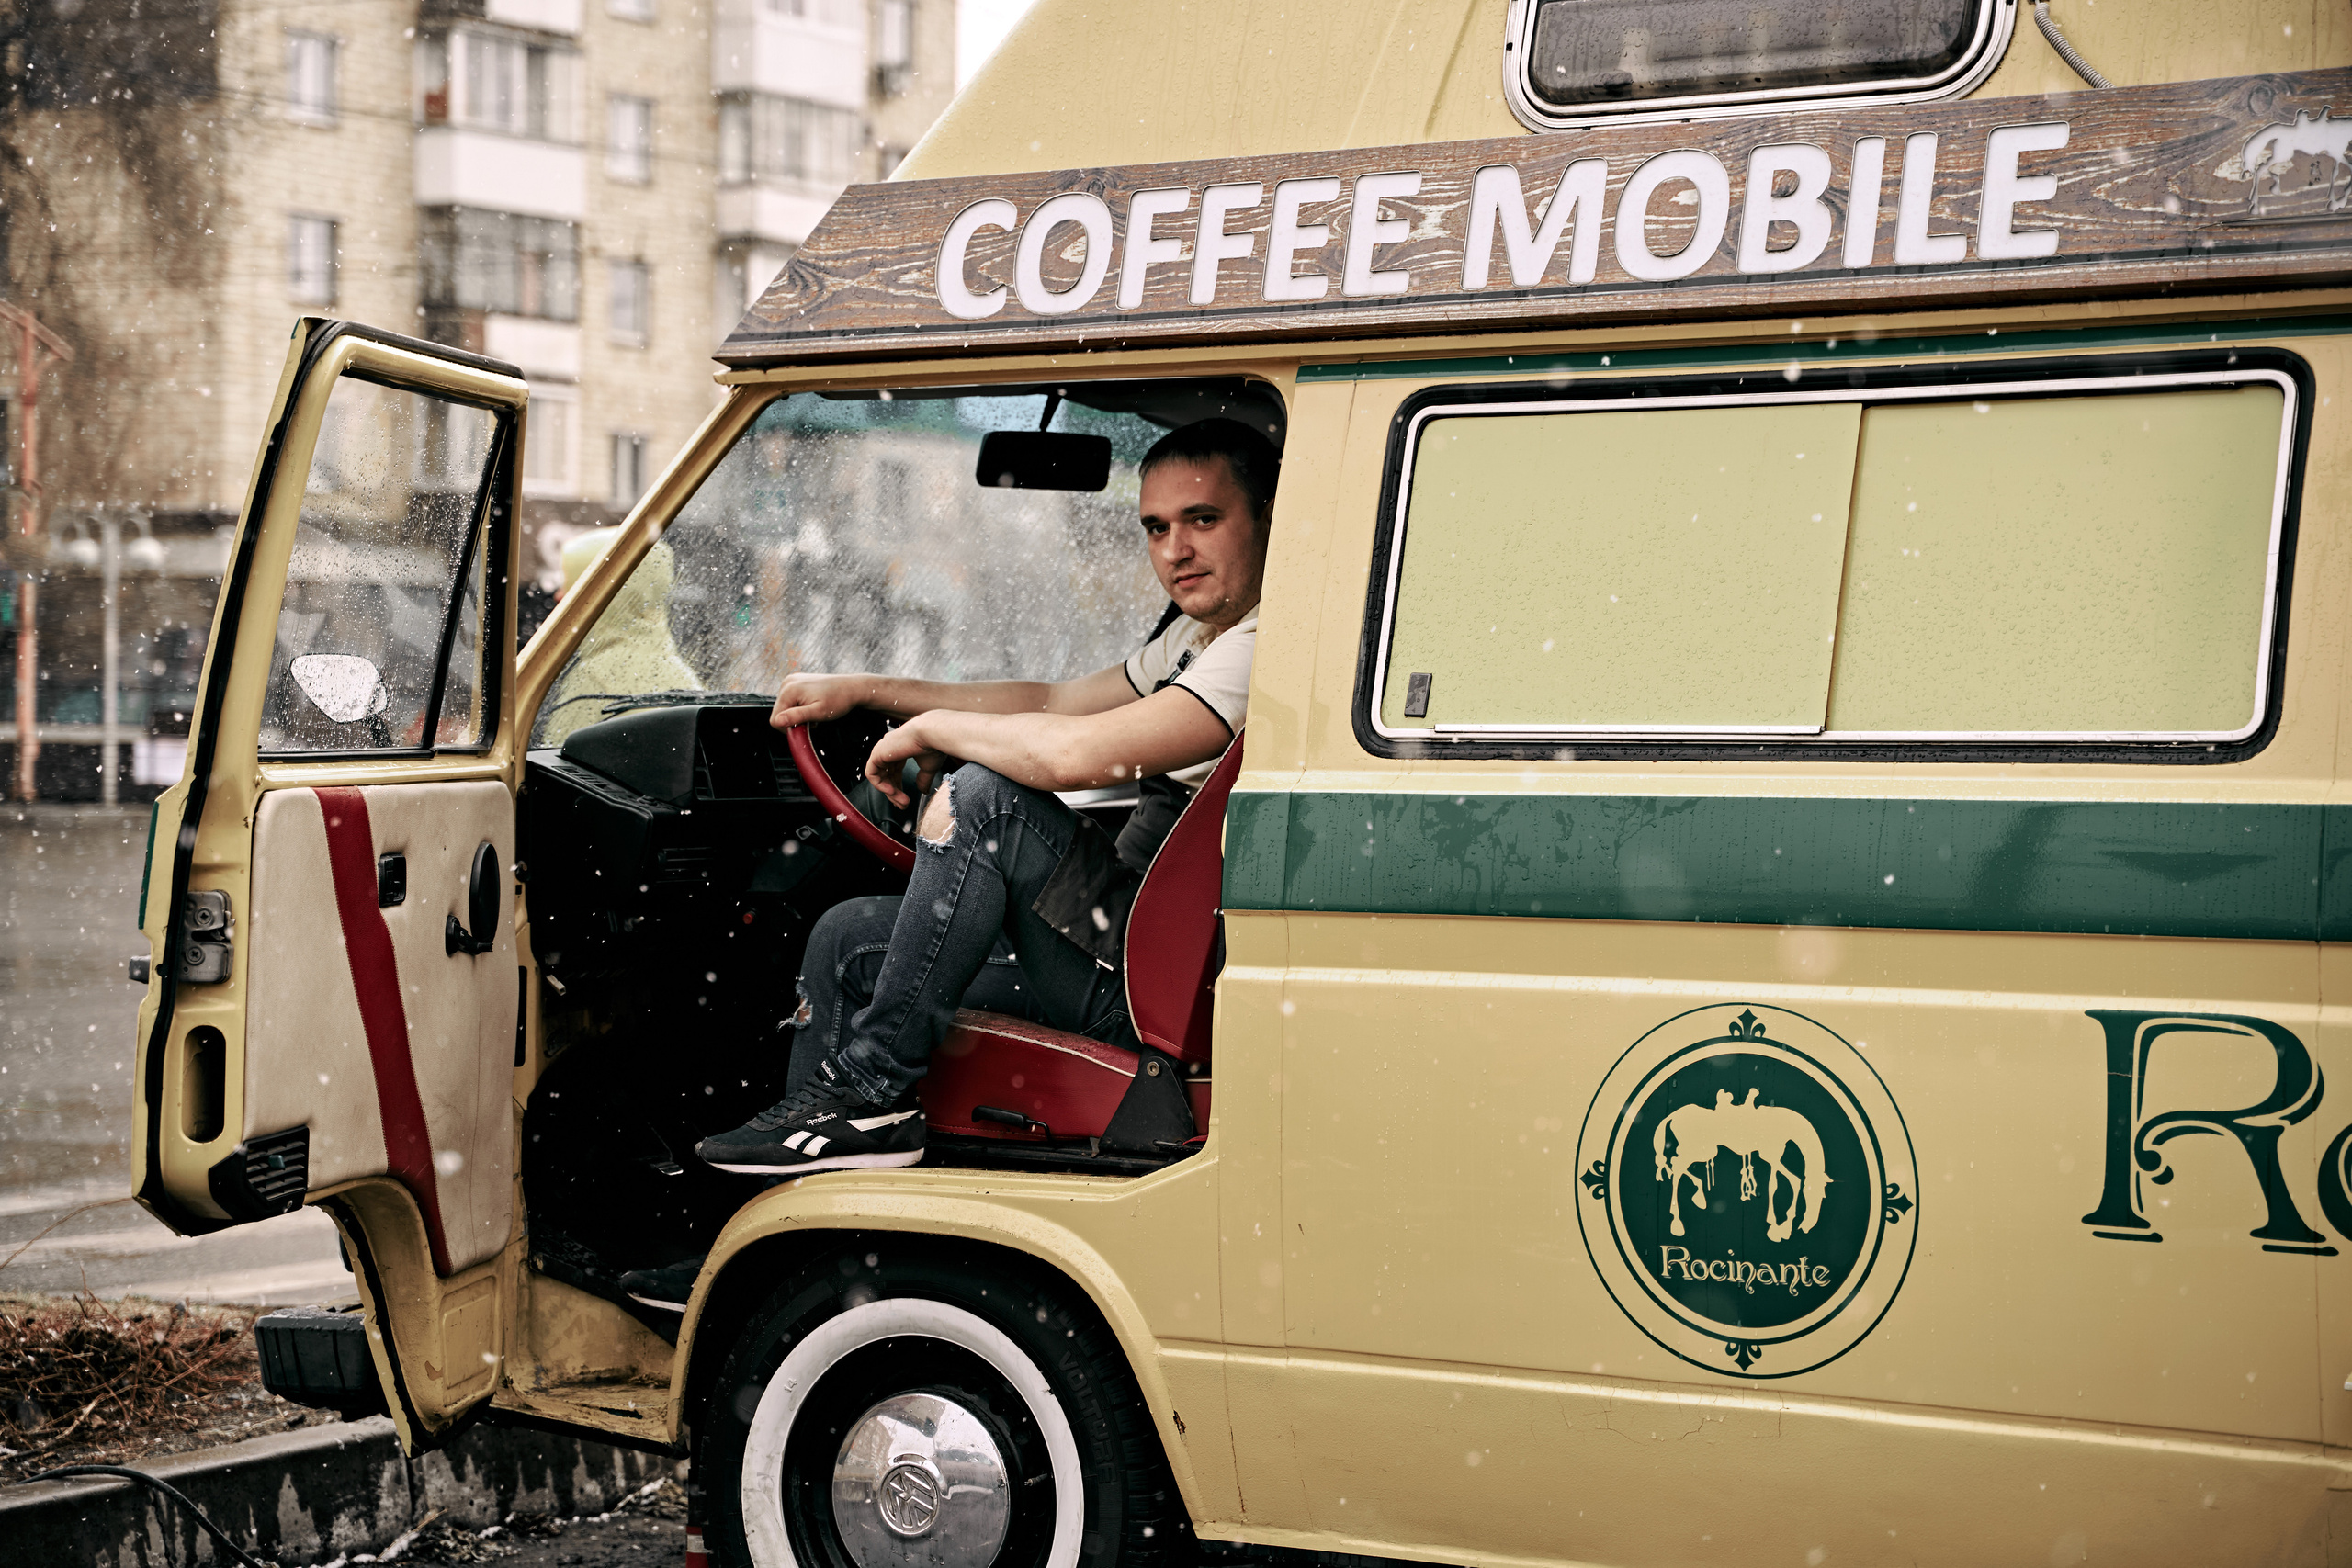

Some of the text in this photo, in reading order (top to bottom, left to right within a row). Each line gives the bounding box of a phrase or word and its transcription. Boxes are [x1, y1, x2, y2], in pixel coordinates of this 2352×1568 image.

[934, 120, 2070, 320] COFFEE MOBILE
[806, 1112, 838, 1126] Reebok
[2081, 1009, 2352, 1257] R
[1659, 1245, 1831, 1297] Rocinante
